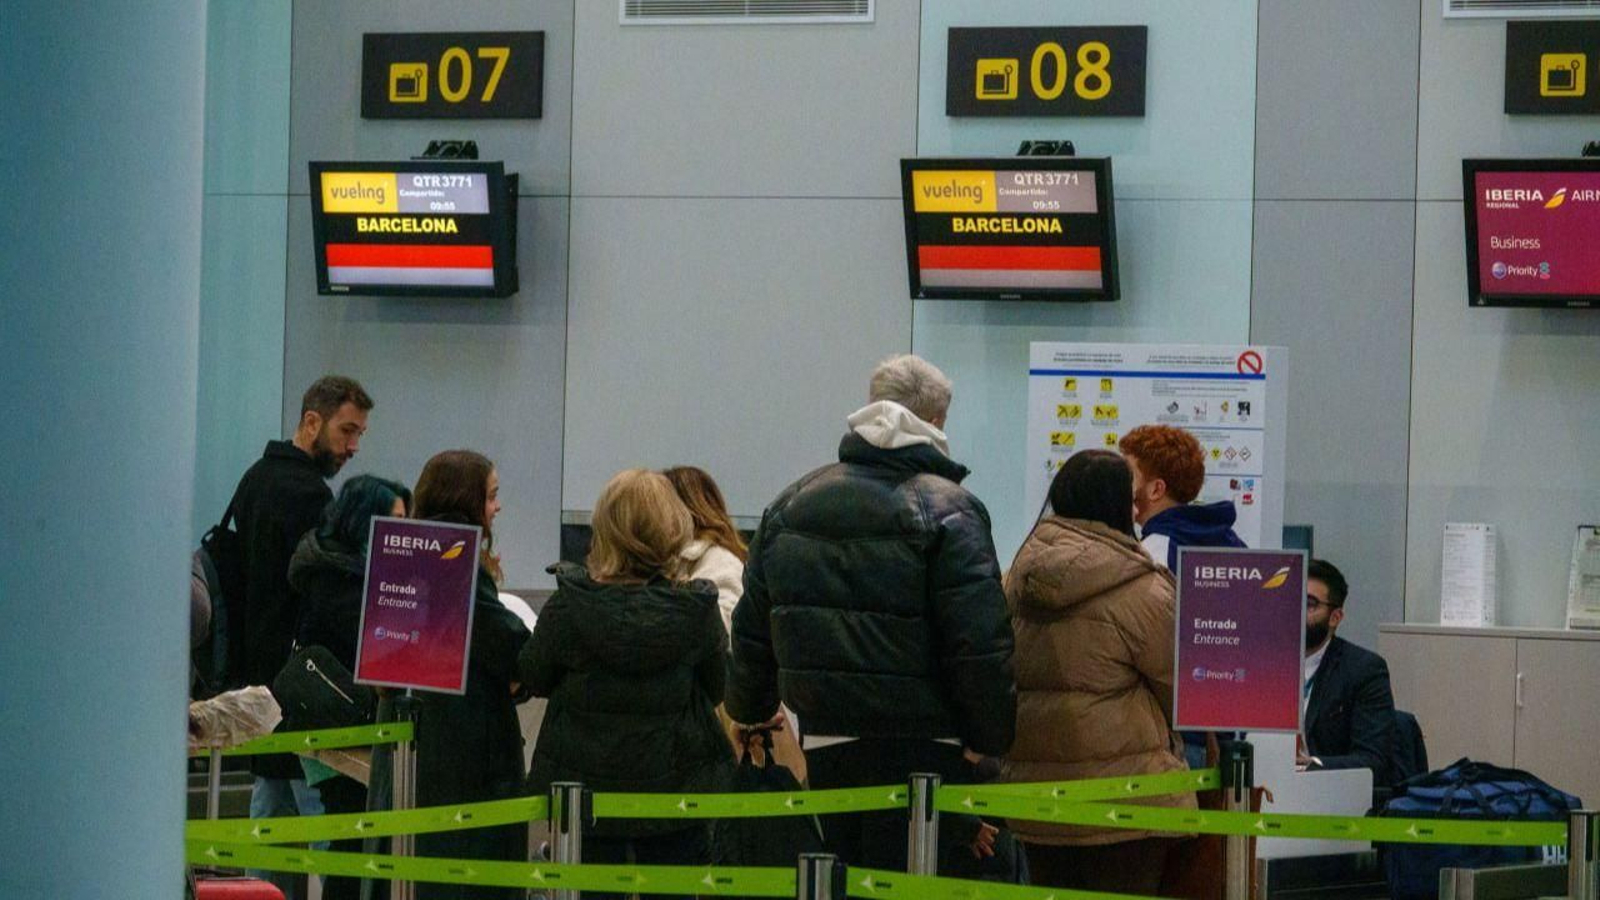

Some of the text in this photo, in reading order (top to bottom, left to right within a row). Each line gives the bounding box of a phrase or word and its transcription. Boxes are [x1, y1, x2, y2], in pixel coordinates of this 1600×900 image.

[438, 47, 510, 102] 07
[1031, 42, 1112, 100] 08
[331, 181, 386, 205] vueling
[923, 180, 983, 204] vueling
[1485, 189, 1543, 201] IBERIA
[356, 217, 458, 233] BARCELONA
[952, 217, 1063, 233] BARCELONA
[1490, 235, 1541, 250] Business
[1508, 264, 1538, 277] Priority
[384, 535, 441, 551] IBERIA
[1195, 567, 1262, 580] IBERIA
[379, 582, 416, 595] Entrada
[378, 597, 418, 609] Entrance
[1194, 618, 1237, 629] Entrada
[1193, 634, 1240, 645] Entrance
[1206, 671, 1234, 682] Priority
